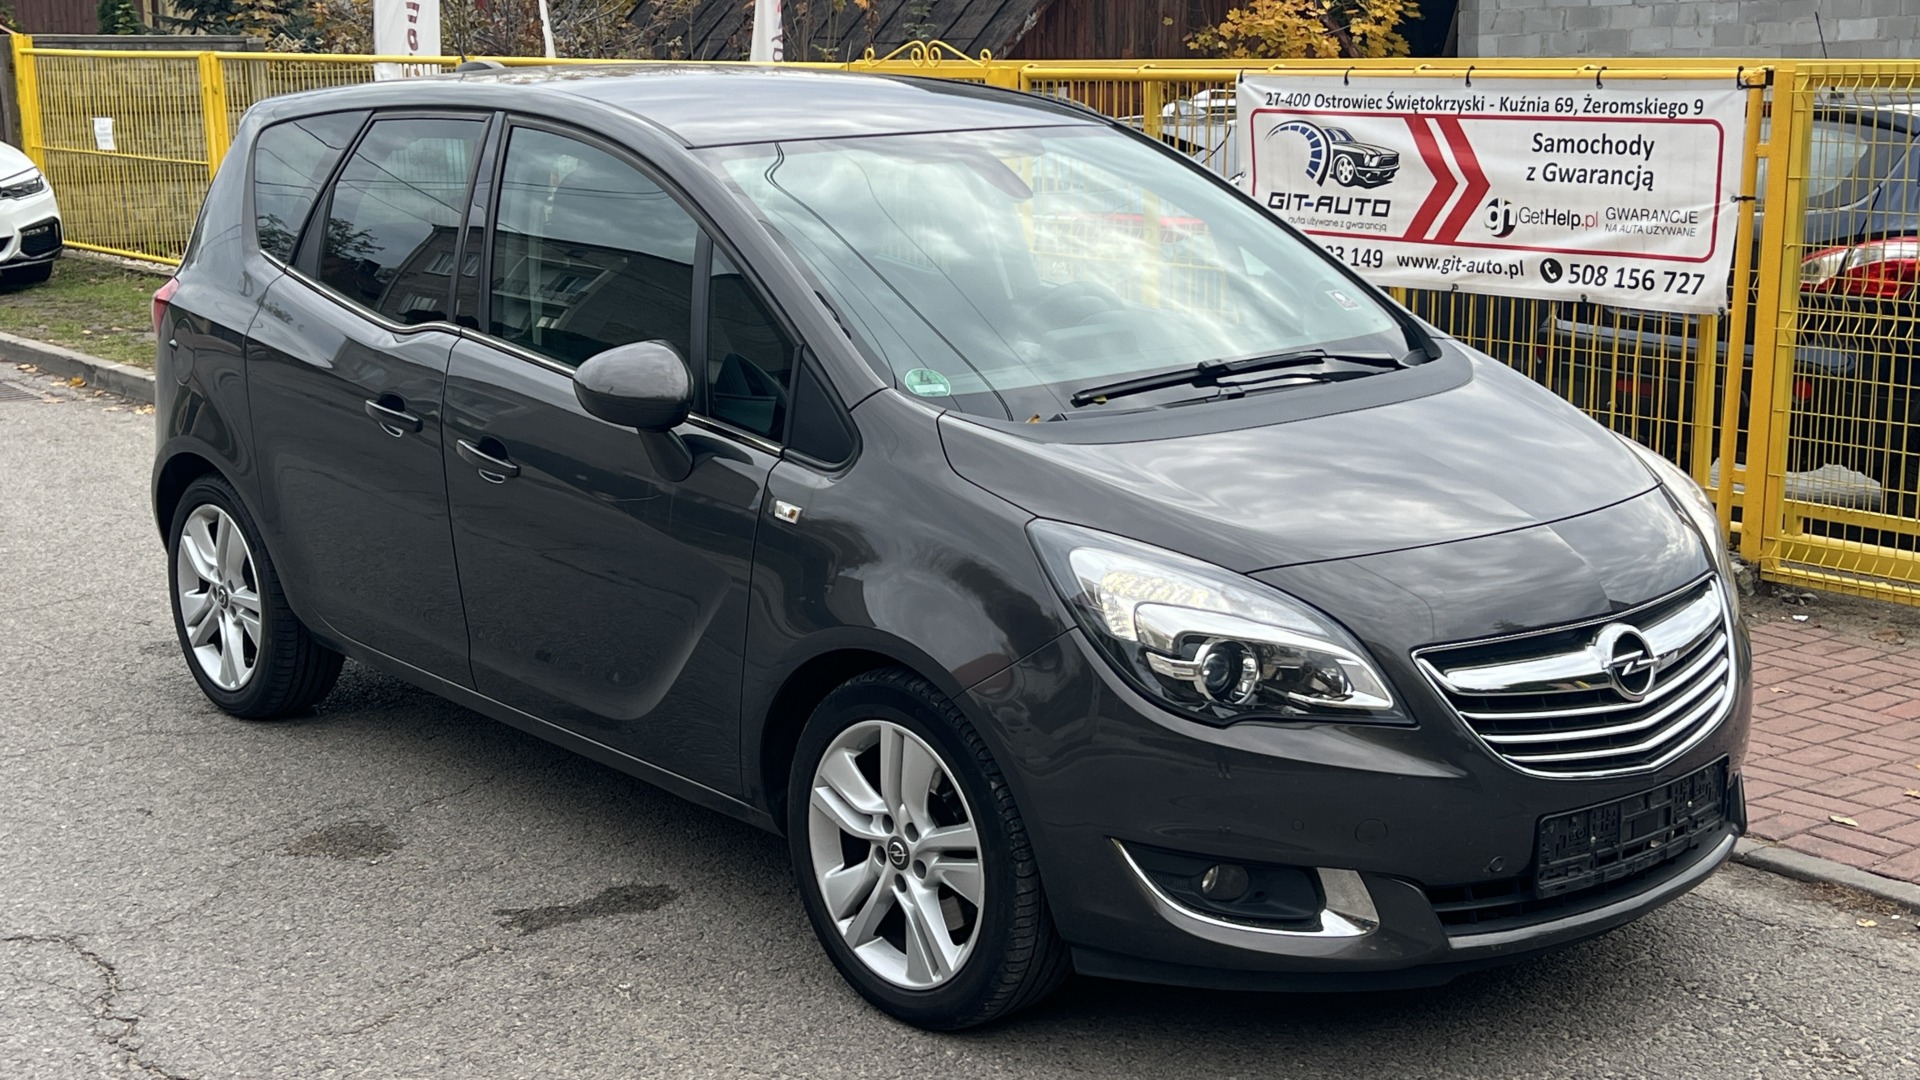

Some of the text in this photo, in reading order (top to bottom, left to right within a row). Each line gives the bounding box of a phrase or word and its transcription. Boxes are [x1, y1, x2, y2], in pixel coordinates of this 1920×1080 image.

[1265, 92, 1311, 107] 27-400
[1314, 93, 1383, 110] Ostrowiec
[1386, 91, 1485, 115] Świętokrzyski
[1499, 95, 1550, 113] Kuźnia
[1555, 97, 1578, 116] 69,
[1583, 94, 1688, 119] Żeromskiego
[1693, 98, 1704, 115] 9
[1531, 132, 1655, 161] Samochody
[1526, 162, 1655, 191] z Gwarancją
[1267, 191, 1391, 218] GIT-AUTO
[1605, 206, 1699, 224] GWARANCJE
[1518, 206, 1599, 231] GetHelp.pl
[1604, 223, 1618, 233] NA
[1619, 224, 1644, 235] AUTA
[1350, 247, 1384, 269] 149
[1396, 255, 1525, 279] www.git-auto.pl
[1567, 263, 1608, 287] 508
[1613, 266, 1656, 291] 156
[1662, 270, 1705, 296] 727
